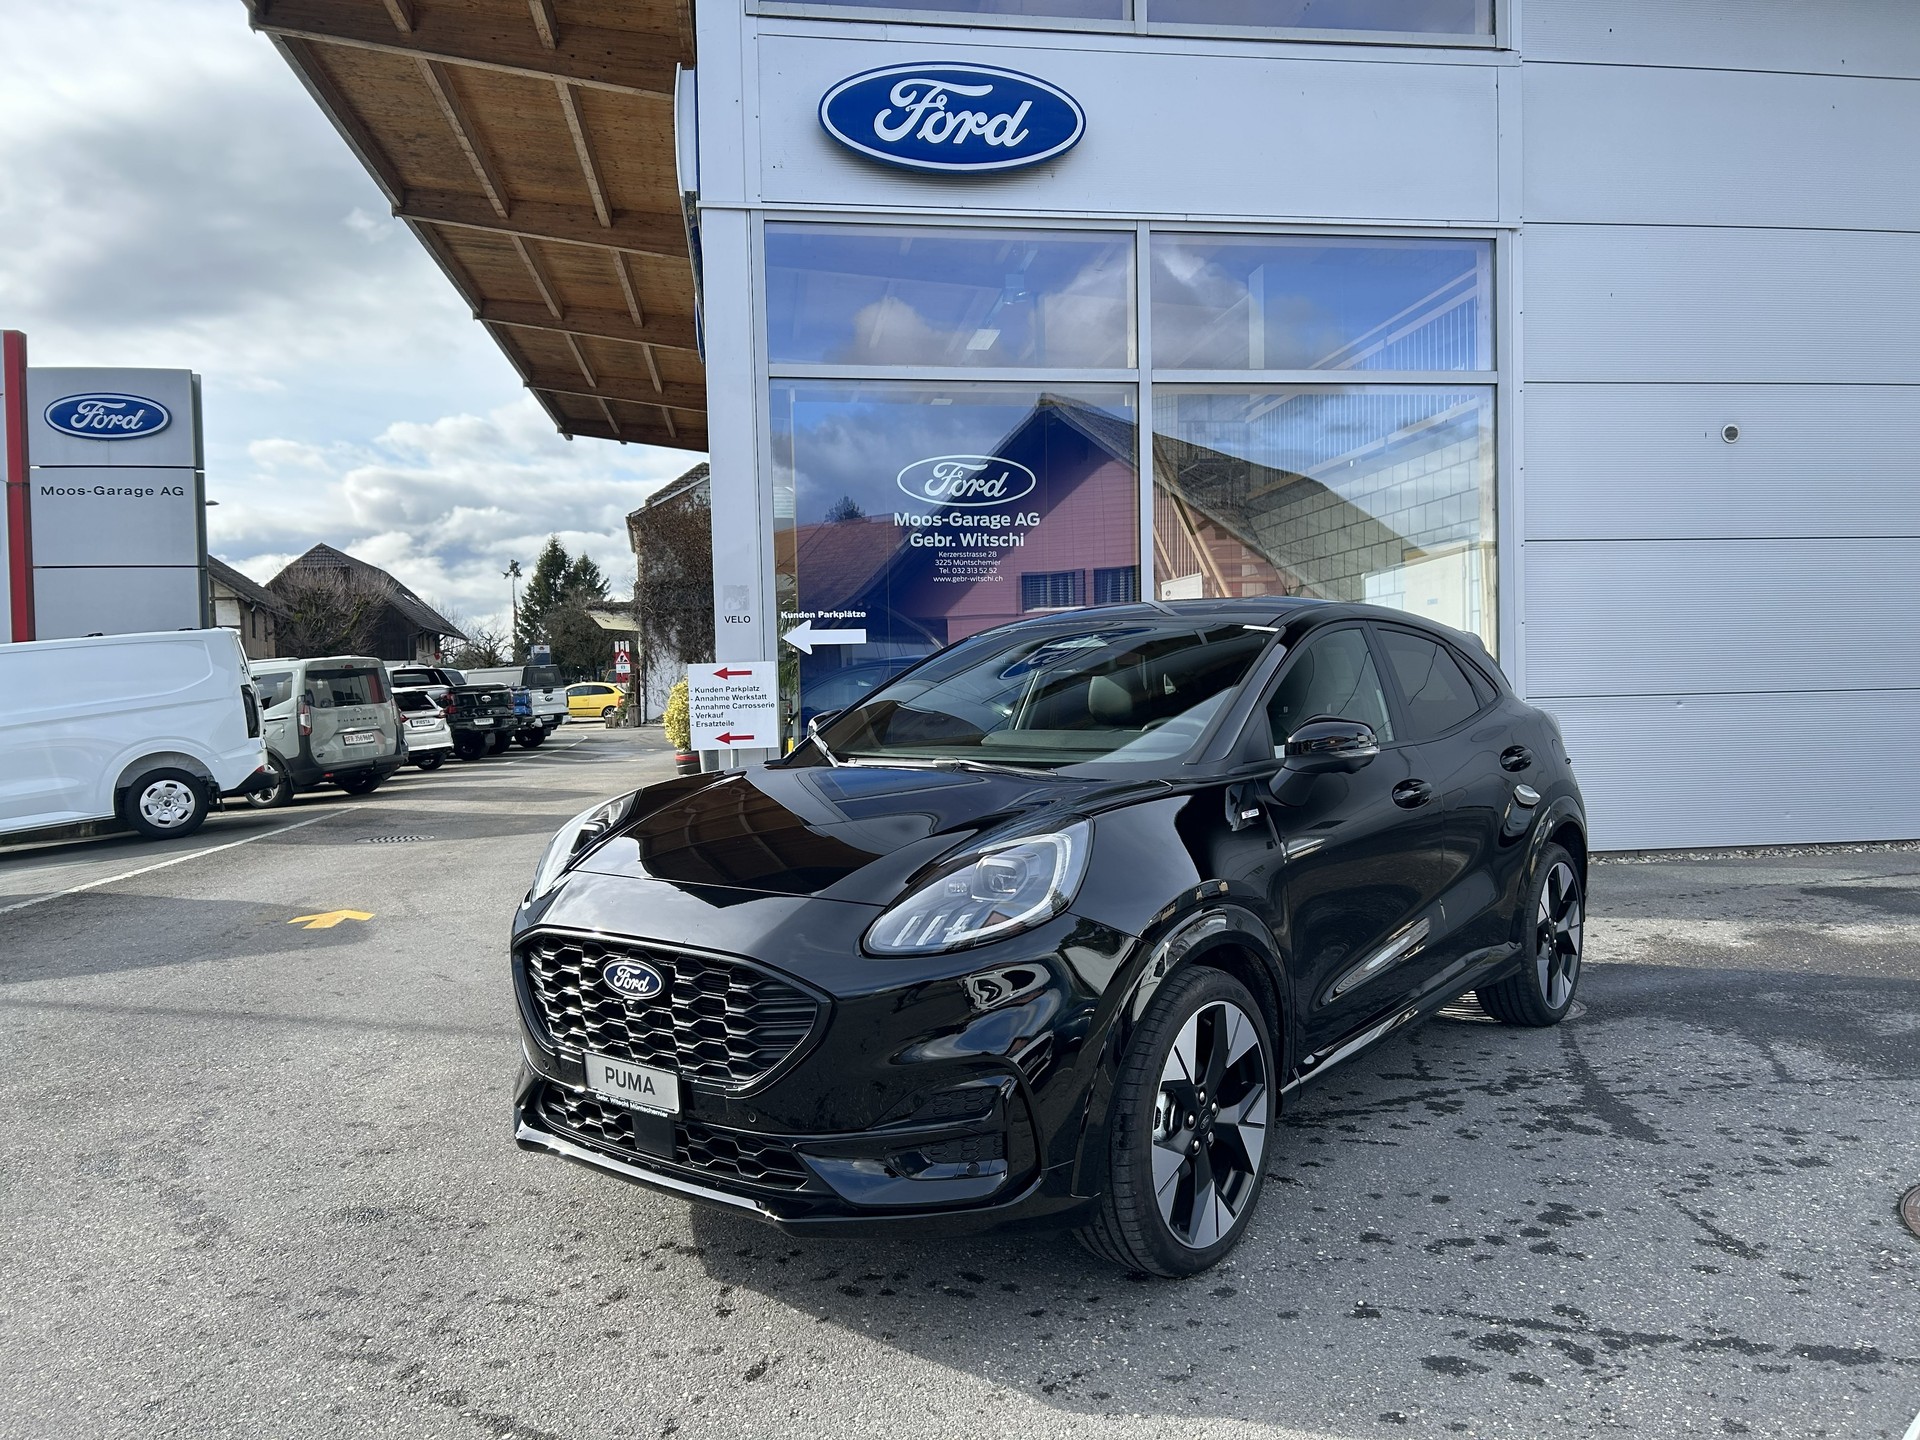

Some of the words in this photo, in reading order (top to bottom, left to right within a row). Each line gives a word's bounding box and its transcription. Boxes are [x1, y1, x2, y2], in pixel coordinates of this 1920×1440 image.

[874, 78, 1033, 147] Ford
[70, 400, 145, 430] Ford
[924, 461, 1010, 498] Ford
[40, 485, 154, 498] Moos-Garage
[160, 486, 184, 496] AG
[893, 512, 1011, 530] Moos-Garage
[1014, 512, 1041, 527] AG
[909, 532, 956, 547] Gebr.
[959, 532, 1025, 547] Witschi
[933, 575, 1004, 583] www.gebr-witschi.ch
[724, 615, 751, 624] VELO
[780, 610, 816, 619] Kunden
[818, 610, 867, 620] Parkplätze
[694, 686, 724, 694] Kunden
[725, 685, 760, 694] Parkplatz
[731, 693, 768, 701] Werkstatt
[694, 703, 731, 711] Annahme
[732, 701, 775, 710] Carrosserie
[695, 711, 724, 719] Verkauf
[695, 720, 735, 728] Ersatzteile
[613, 965, 651, 993] Ford
[605, 1066, 656, 1095] PUMA
